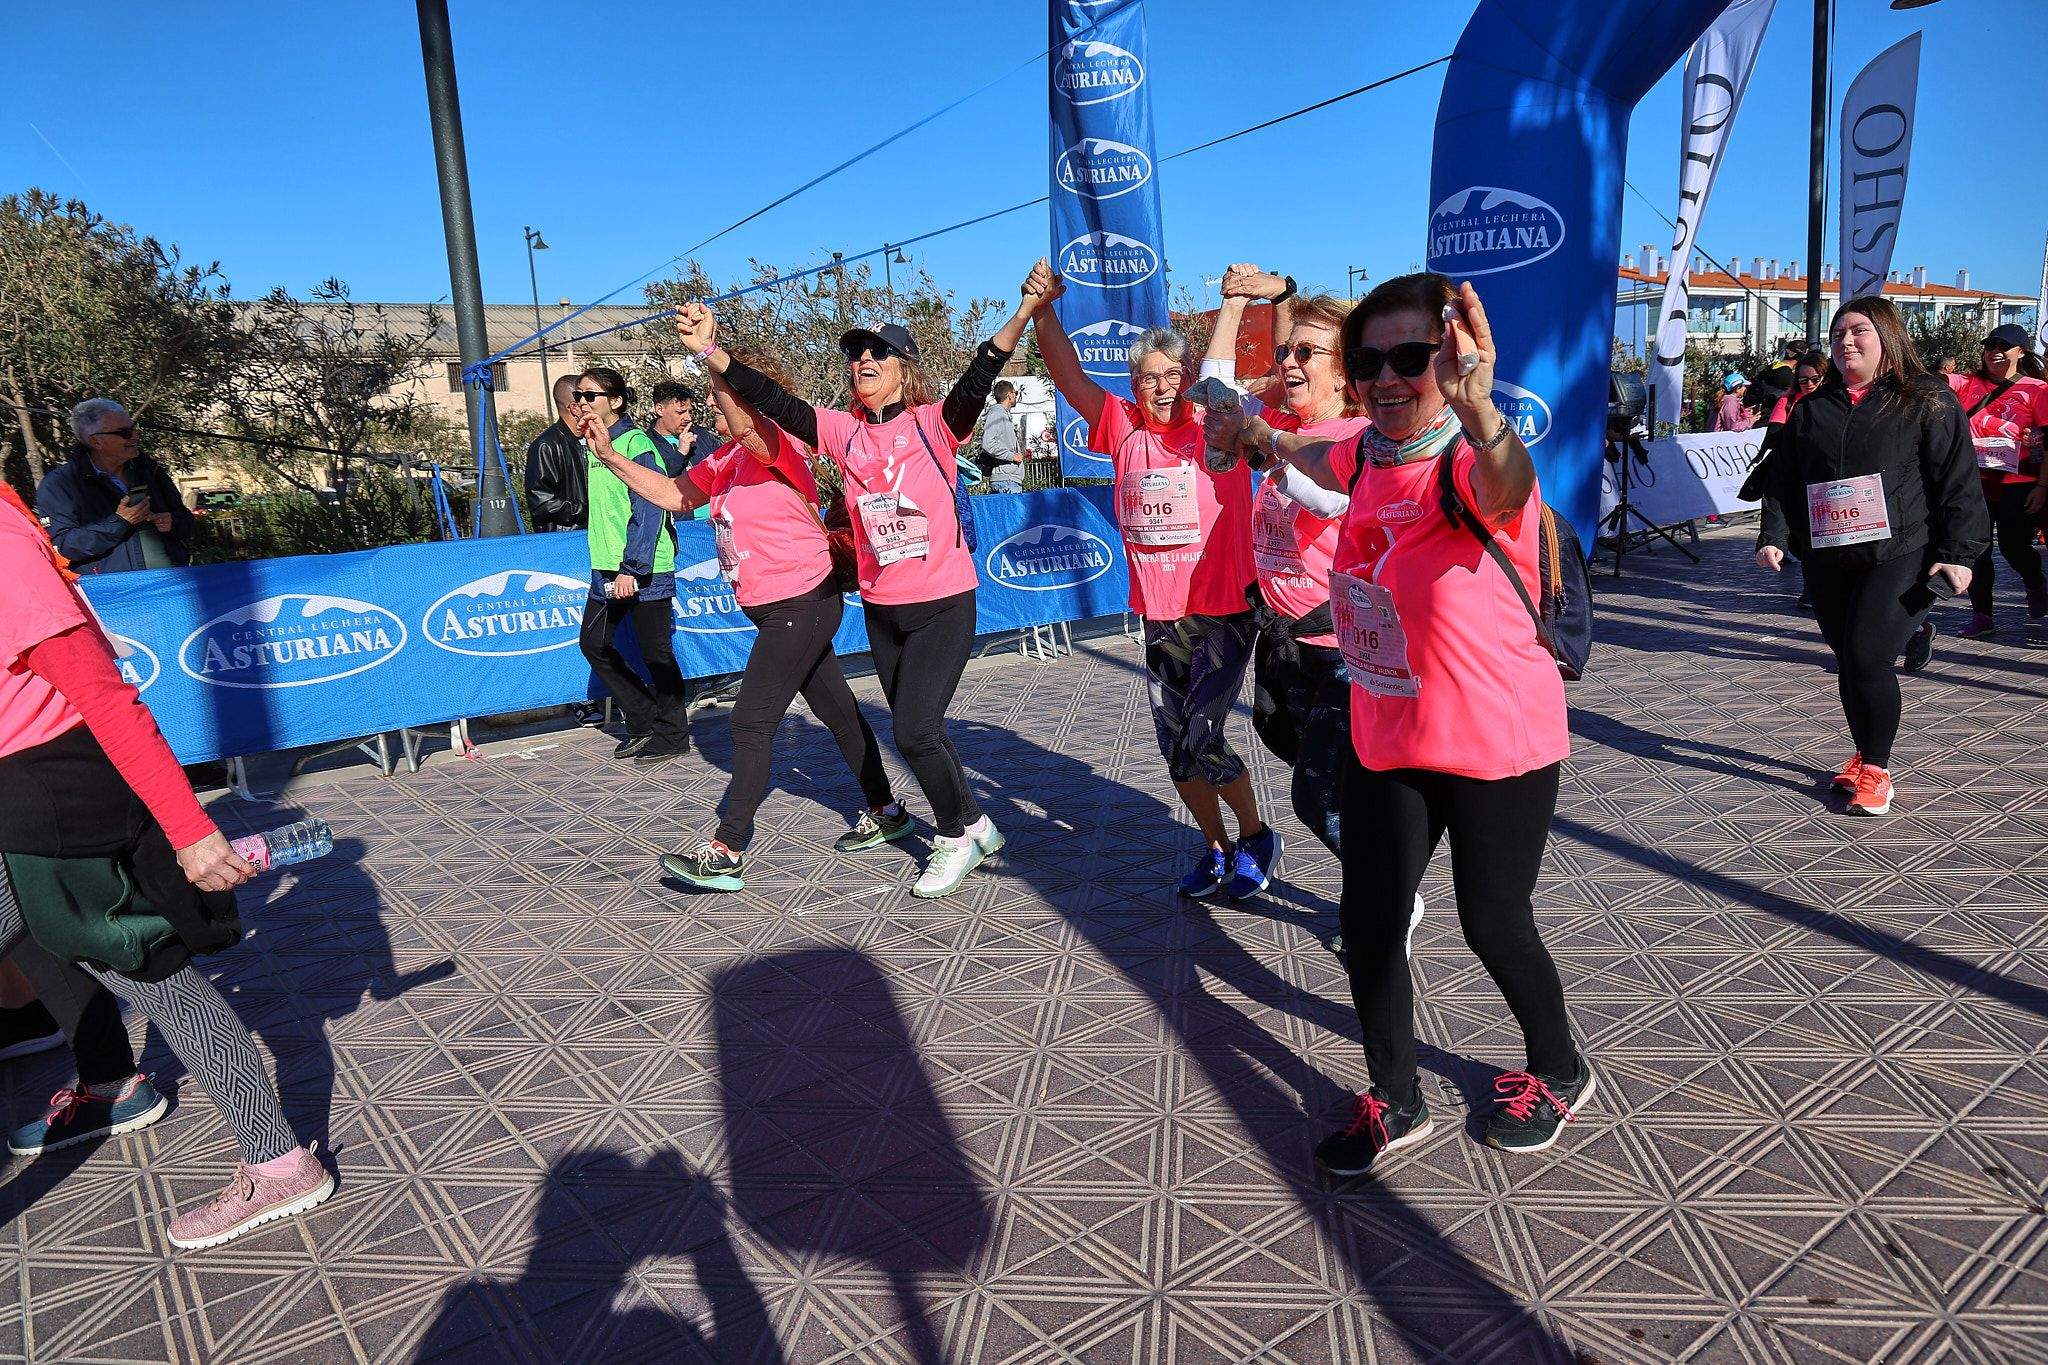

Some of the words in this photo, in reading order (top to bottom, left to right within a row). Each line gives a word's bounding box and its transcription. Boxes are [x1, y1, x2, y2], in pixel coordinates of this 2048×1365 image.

[1438, 217, 1480, 232] CENTRAL
[1485, 213, 1546, 224] LECHERA
[1428, 225, 1551, 261] ASTURIANA
[1685, 443, 1760, 480] OYSHO
[489, 499, 506, 509] 117
[1142, 502, 1173, 516] 016
[1830, 507, 1860, 521] 016
[877, 520, 907, 536] 016
[1015, 545, 1057, 558] CENTRAL
[1059, 542, 1097, 552] LECHERA
[999, 551, 1106, 579] ASTURIANA
[467, 599, 528, 613] CENTRAL
[231, 626, 304, 642] CENTRAL
[311, 615, 381, 631] LECHERA
[440, 605, 584, 643] ASTURIAN
[1353, 626, 1379, 650] 016
[200, 627, 394, 674] ASTURIANA
